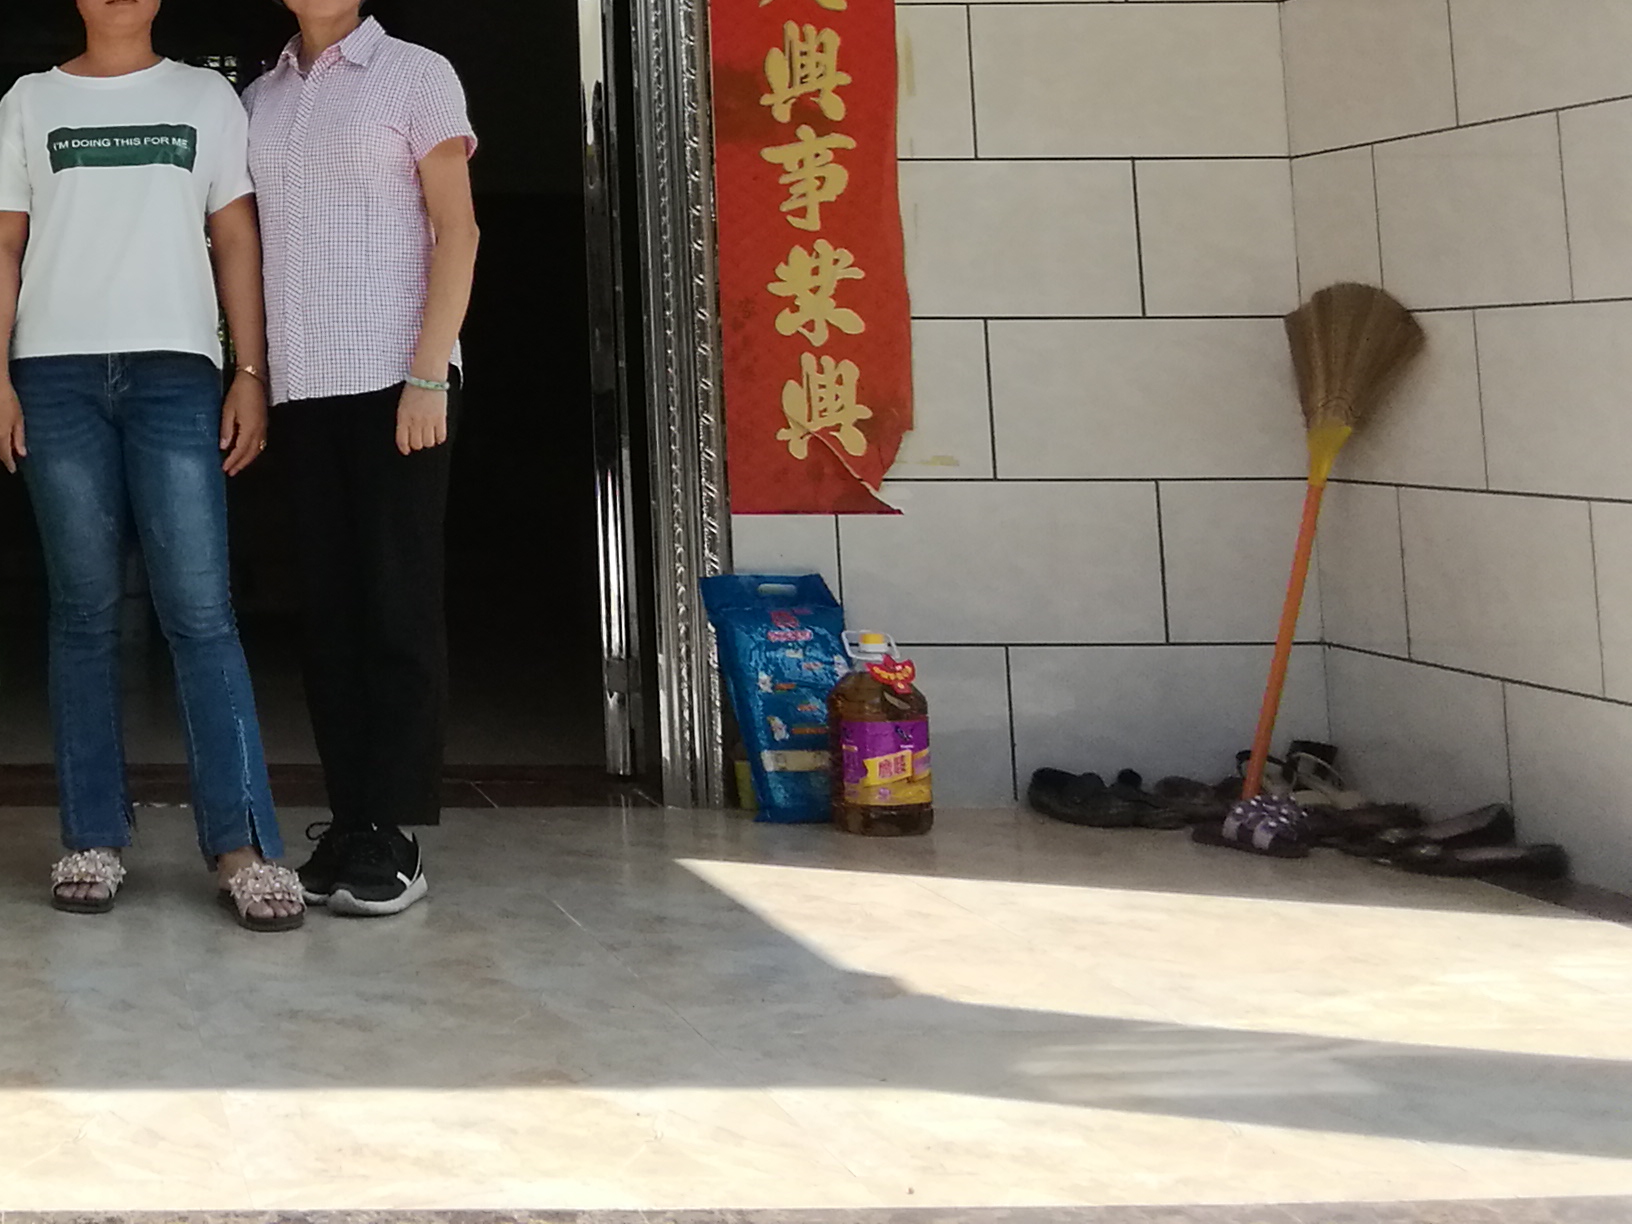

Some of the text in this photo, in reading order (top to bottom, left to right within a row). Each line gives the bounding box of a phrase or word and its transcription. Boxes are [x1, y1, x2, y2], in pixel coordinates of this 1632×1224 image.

[53, 140, 69, 151] I'M
[71, 138, 111, 147] DOING
[112, 136, 141, 147] THIS
[143, 136, 169, 146] FOR
